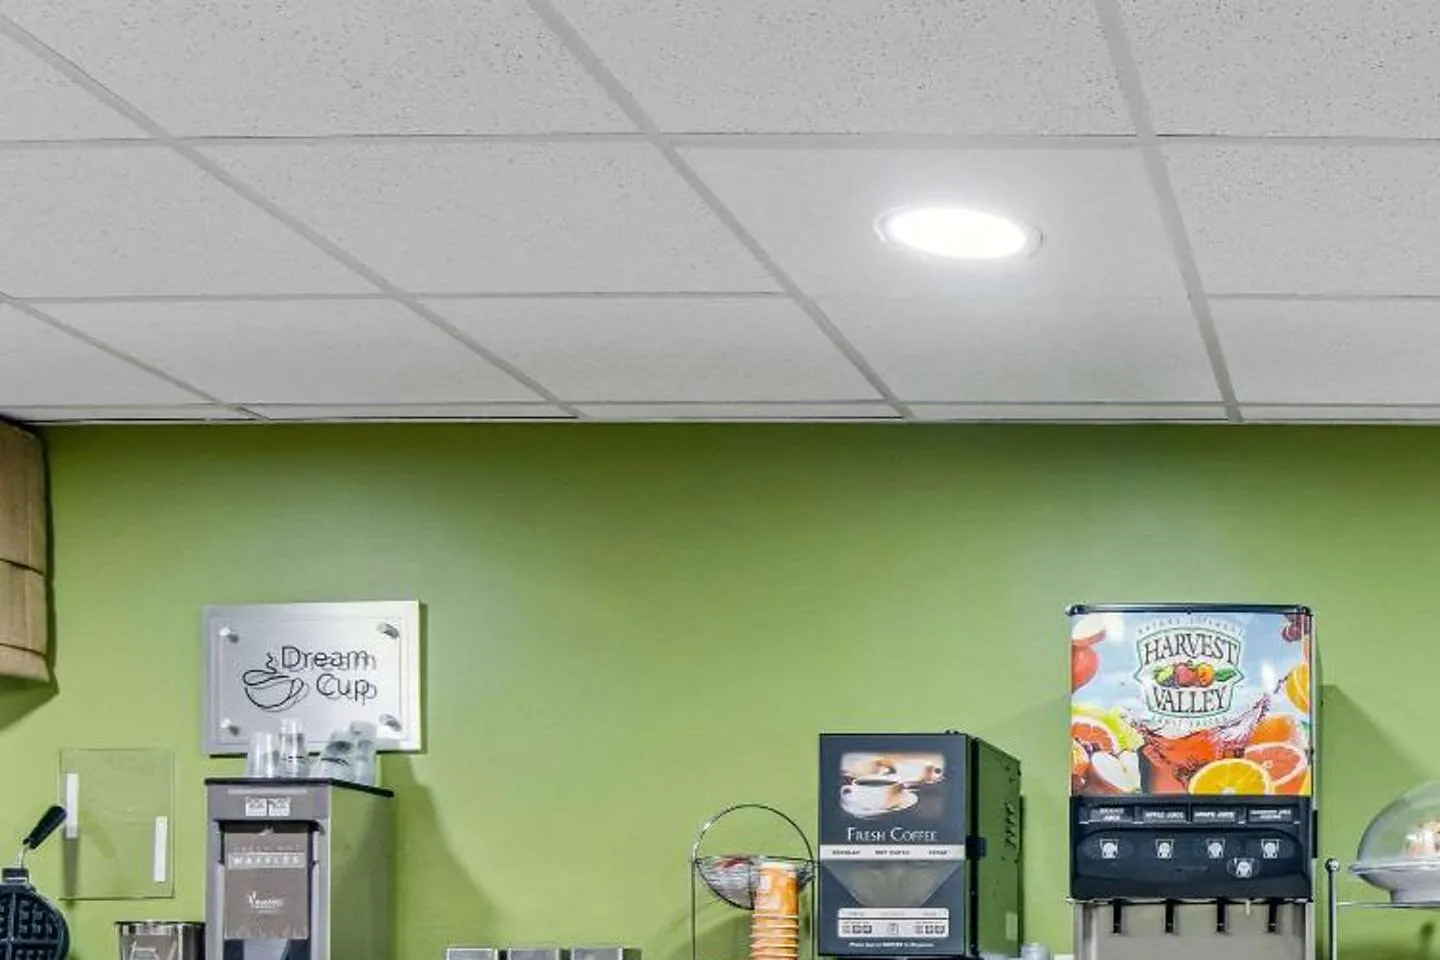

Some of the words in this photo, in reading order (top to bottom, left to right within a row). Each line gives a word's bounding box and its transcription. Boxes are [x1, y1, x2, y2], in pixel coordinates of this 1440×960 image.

[281, 645, 369, 668] Dream
[1144, 632, 1237, 664] HARVEST
[316, 673, 370, 701] Cup
[1153, 685, 1227, 713] VALLEY
[847, 827, 886, 841] FRESH
[890, 827, 938, 841] COFFEE
